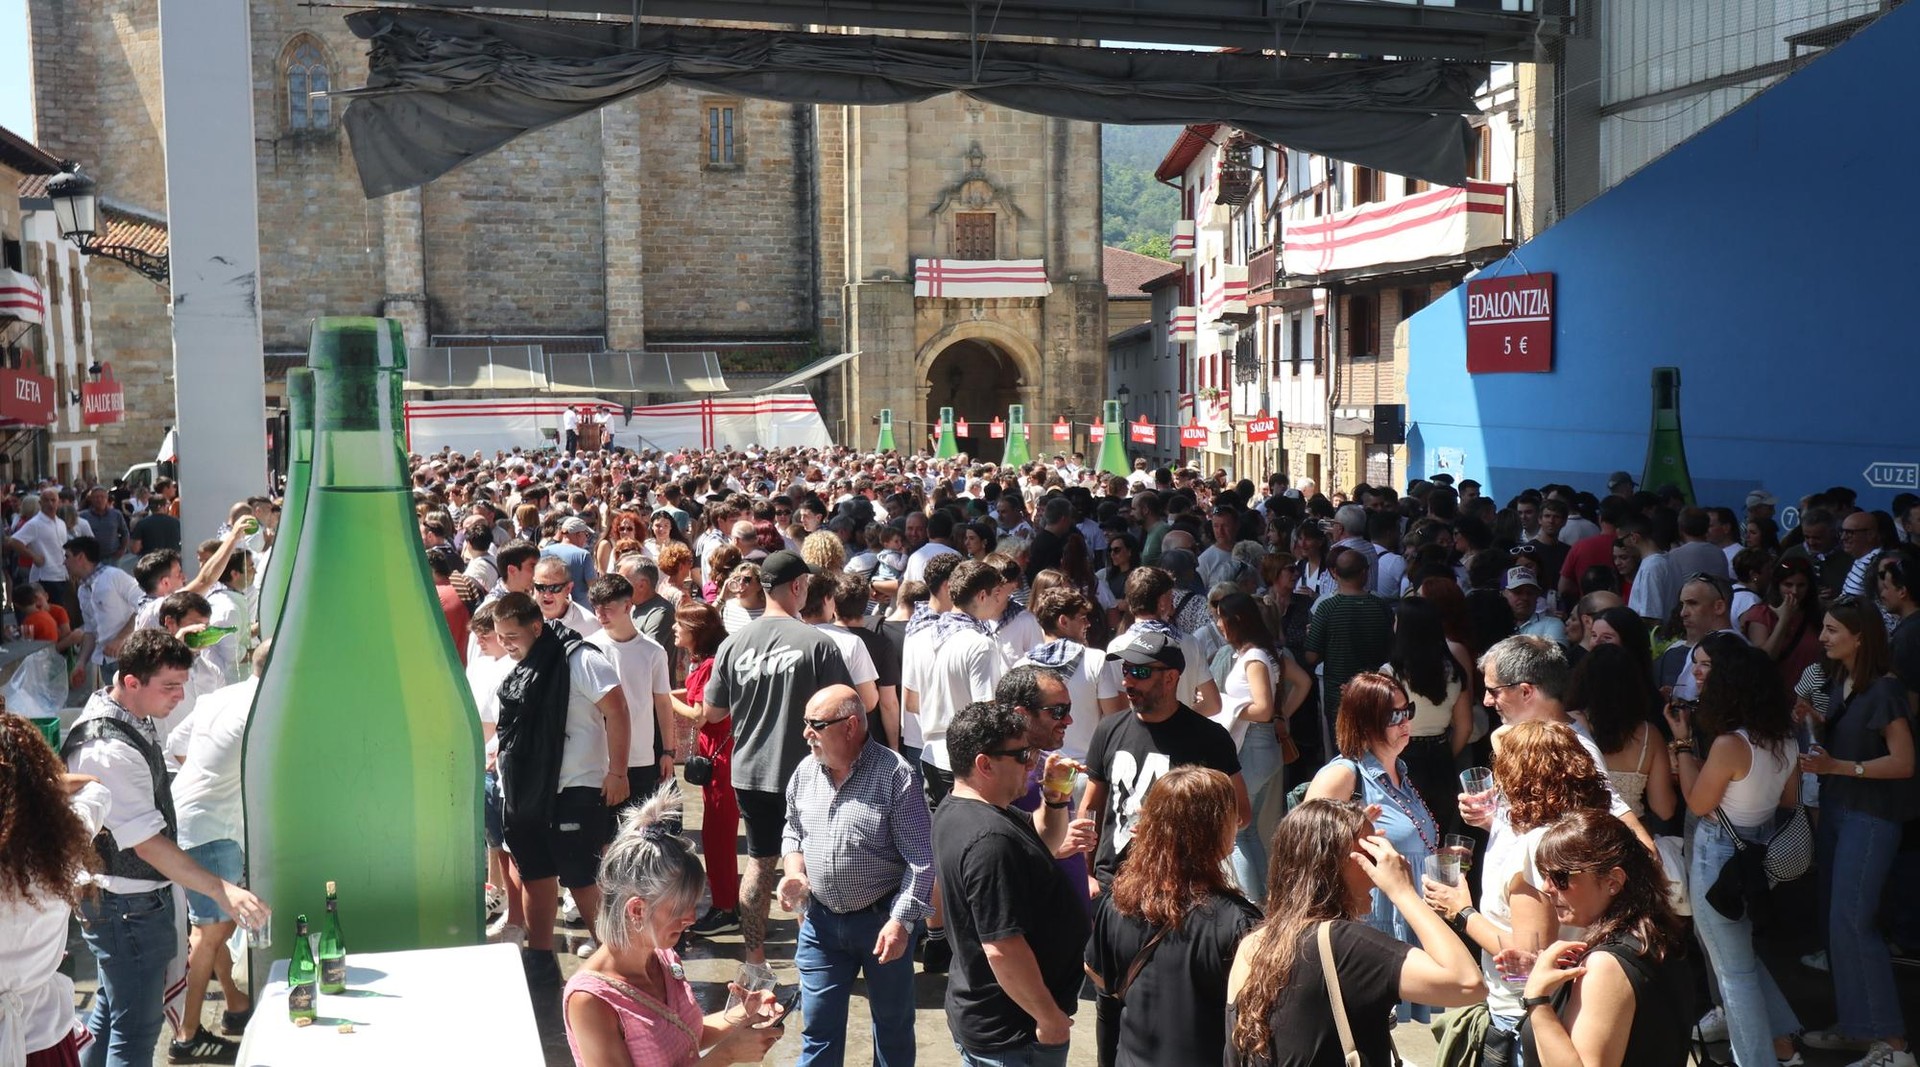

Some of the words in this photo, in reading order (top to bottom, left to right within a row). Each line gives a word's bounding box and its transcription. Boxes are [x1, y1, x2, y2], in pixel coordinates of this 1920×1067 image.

[1468, 288, 1550, 320] EDALONTZIA
[1503, 336, 1512, 355] 5
[1519, 336, 1529, 355] €
[16, 378, 41, 404] IZETA
[84, 393, 111, 414] AIALDE
[1183, 428, 1206, 439] ALTUNA
[1249, 420, 1275, 434] SAIZAR
[1874, 467, 1915, 483] LUZE
[1786, 512, 1795, 525] 7
